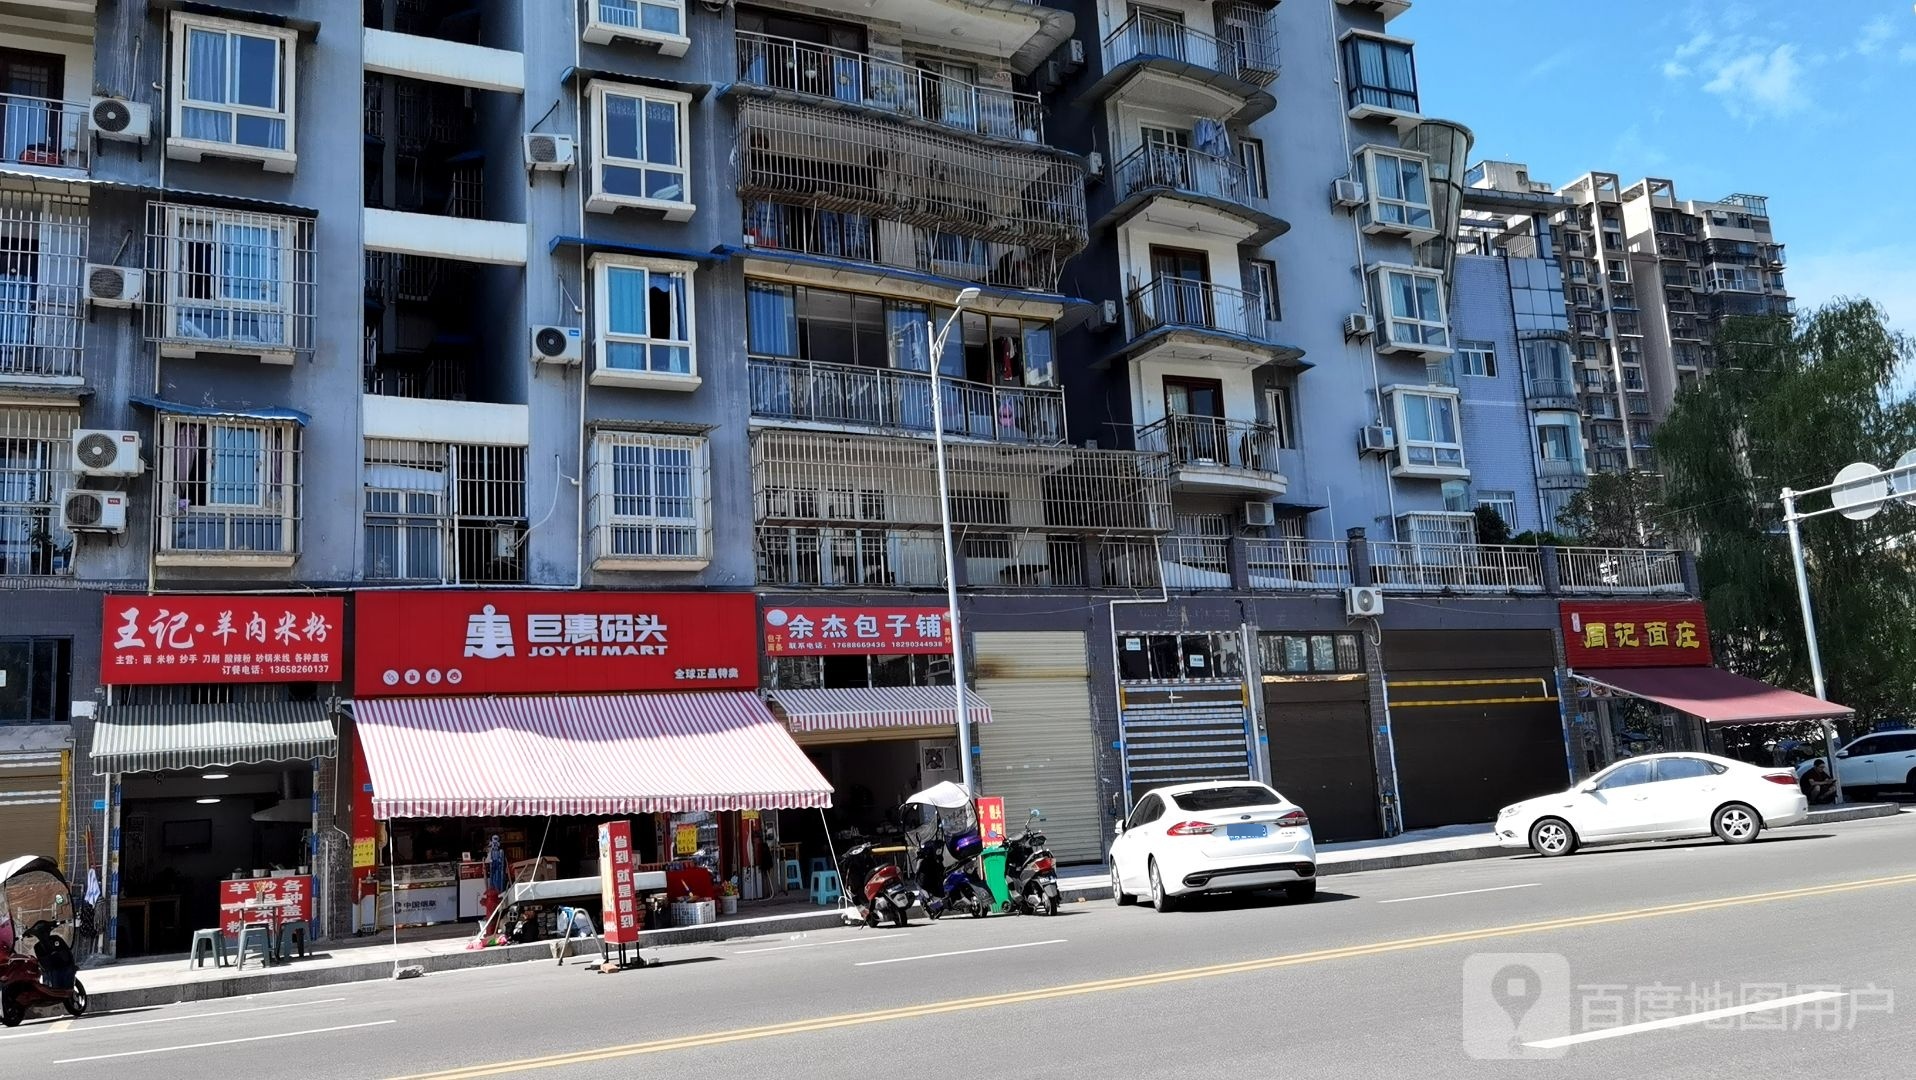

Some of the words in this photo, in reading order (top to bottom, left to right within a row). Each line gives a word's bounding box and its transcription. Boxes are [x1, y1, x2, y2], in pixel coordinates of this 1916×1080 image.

[527, 613, 668, 643] 巨惠码头
[787, 613, 941, 639] 余杰包子铺
[767, 634, 783, 643] 包子
[1584, 621, 1700, 649] 周记面庄
[528, 645, 572, 657] JOY
[601, 645, 669, 656] MART
[156, 655, 175, 664] 米粉
[179, 654, 198, 664] 抄手
[202, 654, 220, 664] 刀削
[224, 654, 252, 664] 酸辣粉
[255, 654, 291, 664] 砂锅米线
[294, 653, 329, 663] 各种盖饭
[269, 665, 330, 674] 13658260137
